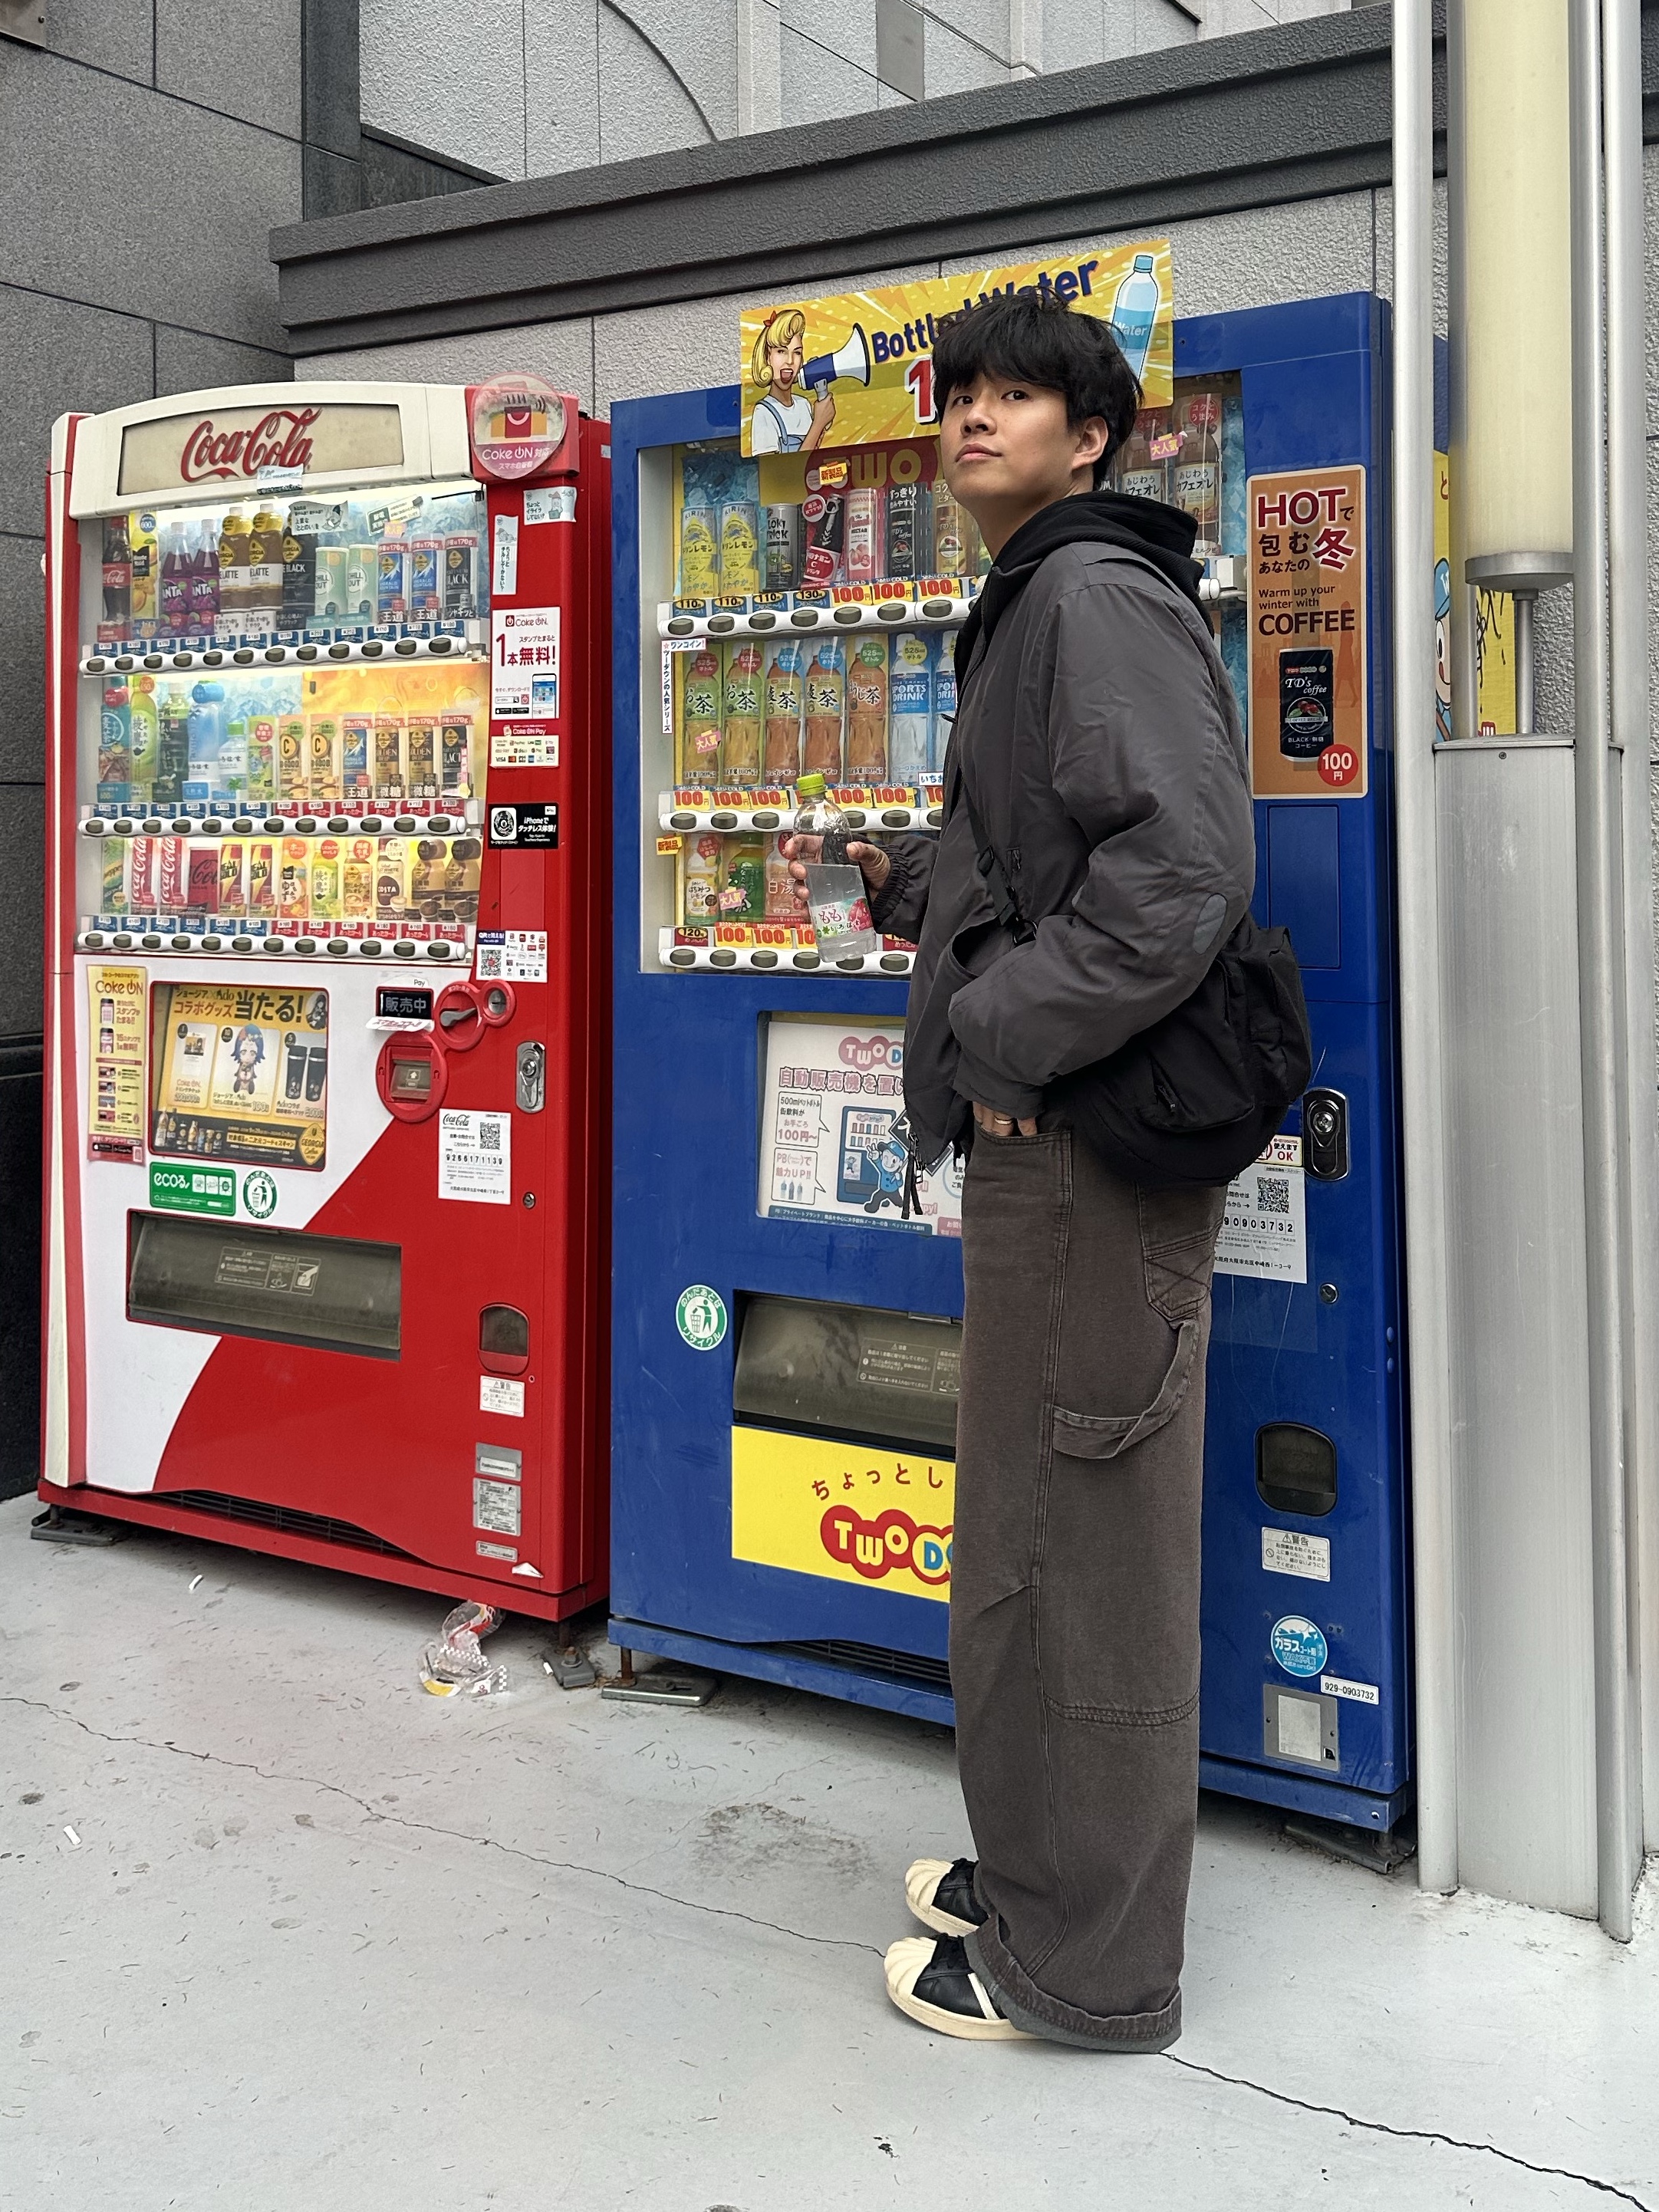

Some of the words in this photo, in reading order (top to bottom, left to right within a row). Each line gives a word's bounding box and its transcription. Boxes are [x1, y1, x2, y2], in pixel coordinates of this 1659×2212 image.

[181, 407, 322, 482] Coca-Cola
[1150, 439, 1179, 456] 大人気
[482, 448, 512, 460] Coke
[515, 446, 533, 459] ON
[1176, 478, 1213, 492] カフェオレ
[725, 506, 746, 515] KIRIN
[1256, 487, 1355, 528] HOTで
[1258, 531, 1310, 558] 包む
[1312, 527, 1355, 571] 冬
[287, 562, 306, 574] BLACK
[1258, 559, 1310, 574] あなたの
[1258, 587, 1291, 598] Warm
[1293, 588, 1308, 599] up
[1312, 584, 1336, 597] your
[1258, 598, 1293, 610] winter
[1296, 597, 1319, 607] with
[383, 612, 404, 623] 王道
[416, 610, 438, 620] 王道
[515, 617, 534, 627] Coke
[1258, 610, 1356, 636] COFFEE
[670, 639, 706, 650] ワンコイン!
[891, 684, 927, 694] SPORTS
[1285, 676, 1312, 689] TD's
[892, 693, 924, 701] DRINK
[1303, 684, 1328, 696] coffee
[696, 734, 718, 749] 大人気
[1322, 752, 1353, 770] 100
[1333, 770, 1343, 781] 円
[347, 786, 369, 798] 王道
[688, 886, 711, 894] はちみつ
[768, 878, 796, 895] 白湯
[719, 893, 742, 906] 大人気
[818, 908, 842, 924] もも
[95, 980, 125, 995] Coke
[127, 979, 143, 995] ON
[413, 979, 425, 987] Pay
[174, 1000, 233, 1019] コラボグッズ
[233, 989, 303, 1023] 当たる!
[385, 996, 426, 1014] 販売中
[784, 1118, 808, 1128] お手ごろ
[1277, 1151, 1294, 1162] OK
[680, 1286, 723, 1310] のんだあとは
[682, 1327, 722, 1348] リサイクル
[811, 1462, 943, 1500] ちょっとし
[834, 1519, 910, 1566] TWO
[1325, 1682, 1374, 1700] 929-0903732
